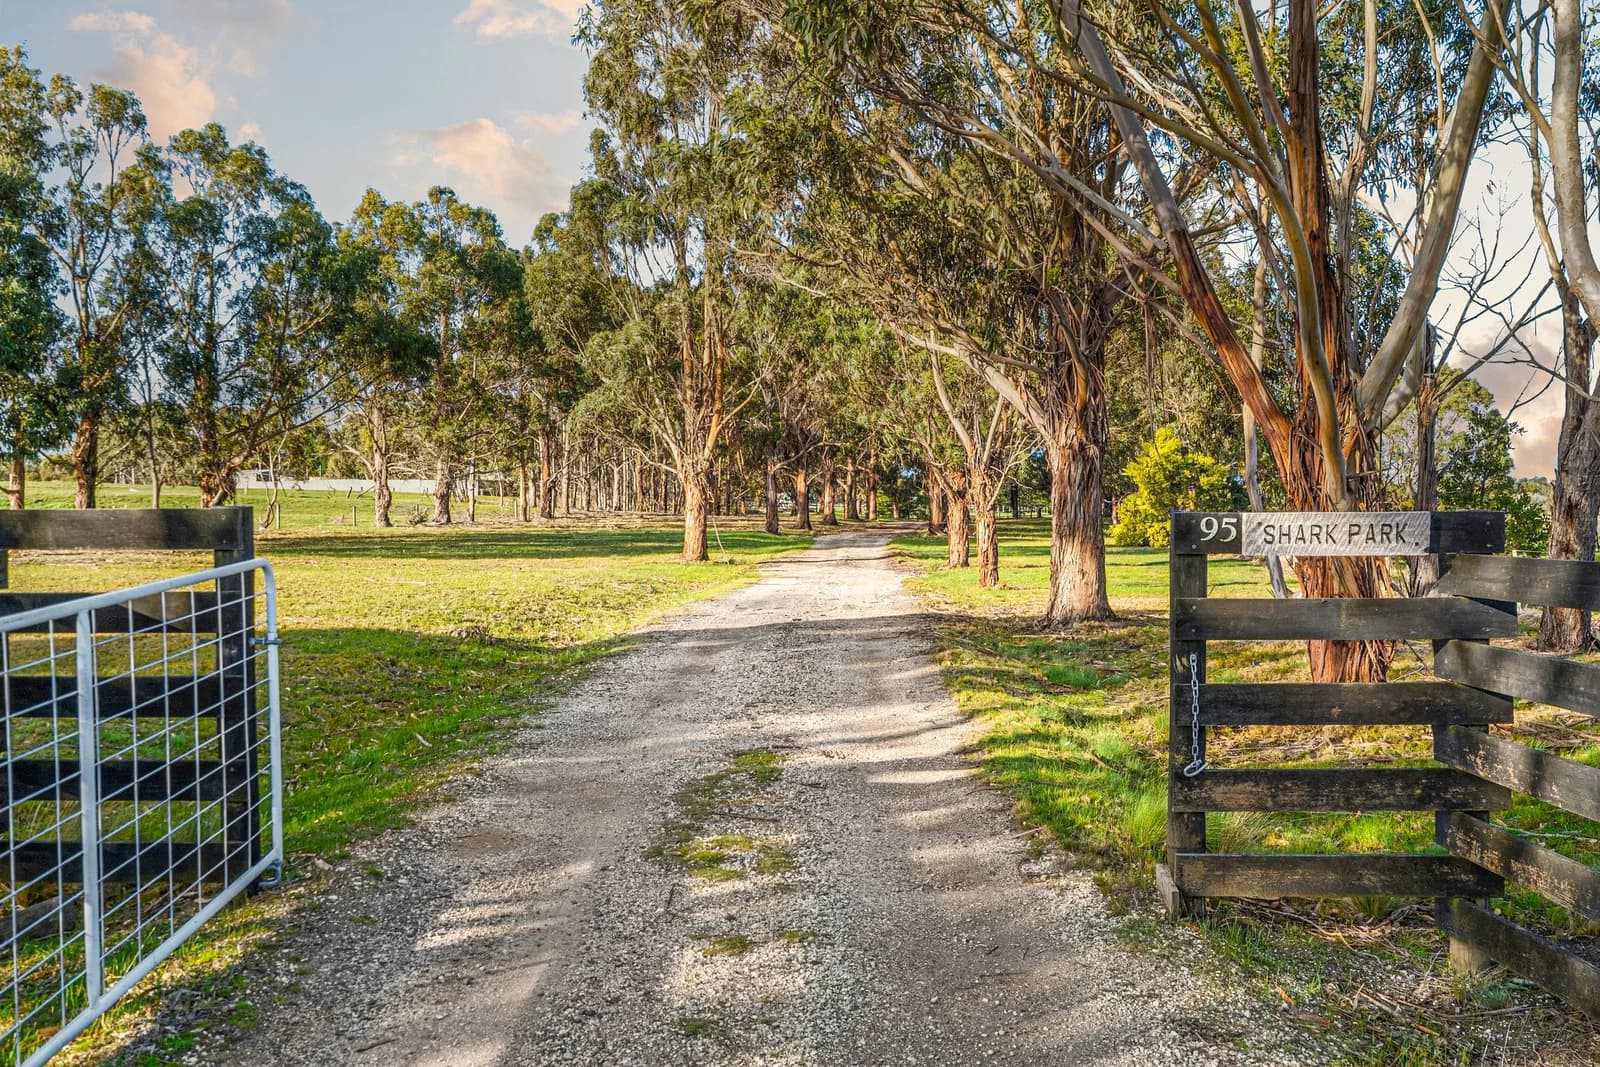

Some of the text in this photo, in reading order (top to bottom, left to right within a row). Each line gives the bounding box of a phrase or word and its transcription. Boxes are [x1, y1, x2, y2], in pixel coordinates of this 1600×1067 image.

[1200, 516, 1238, 543] 95
[1263, 522, 1408, 545] SHARK PARK
